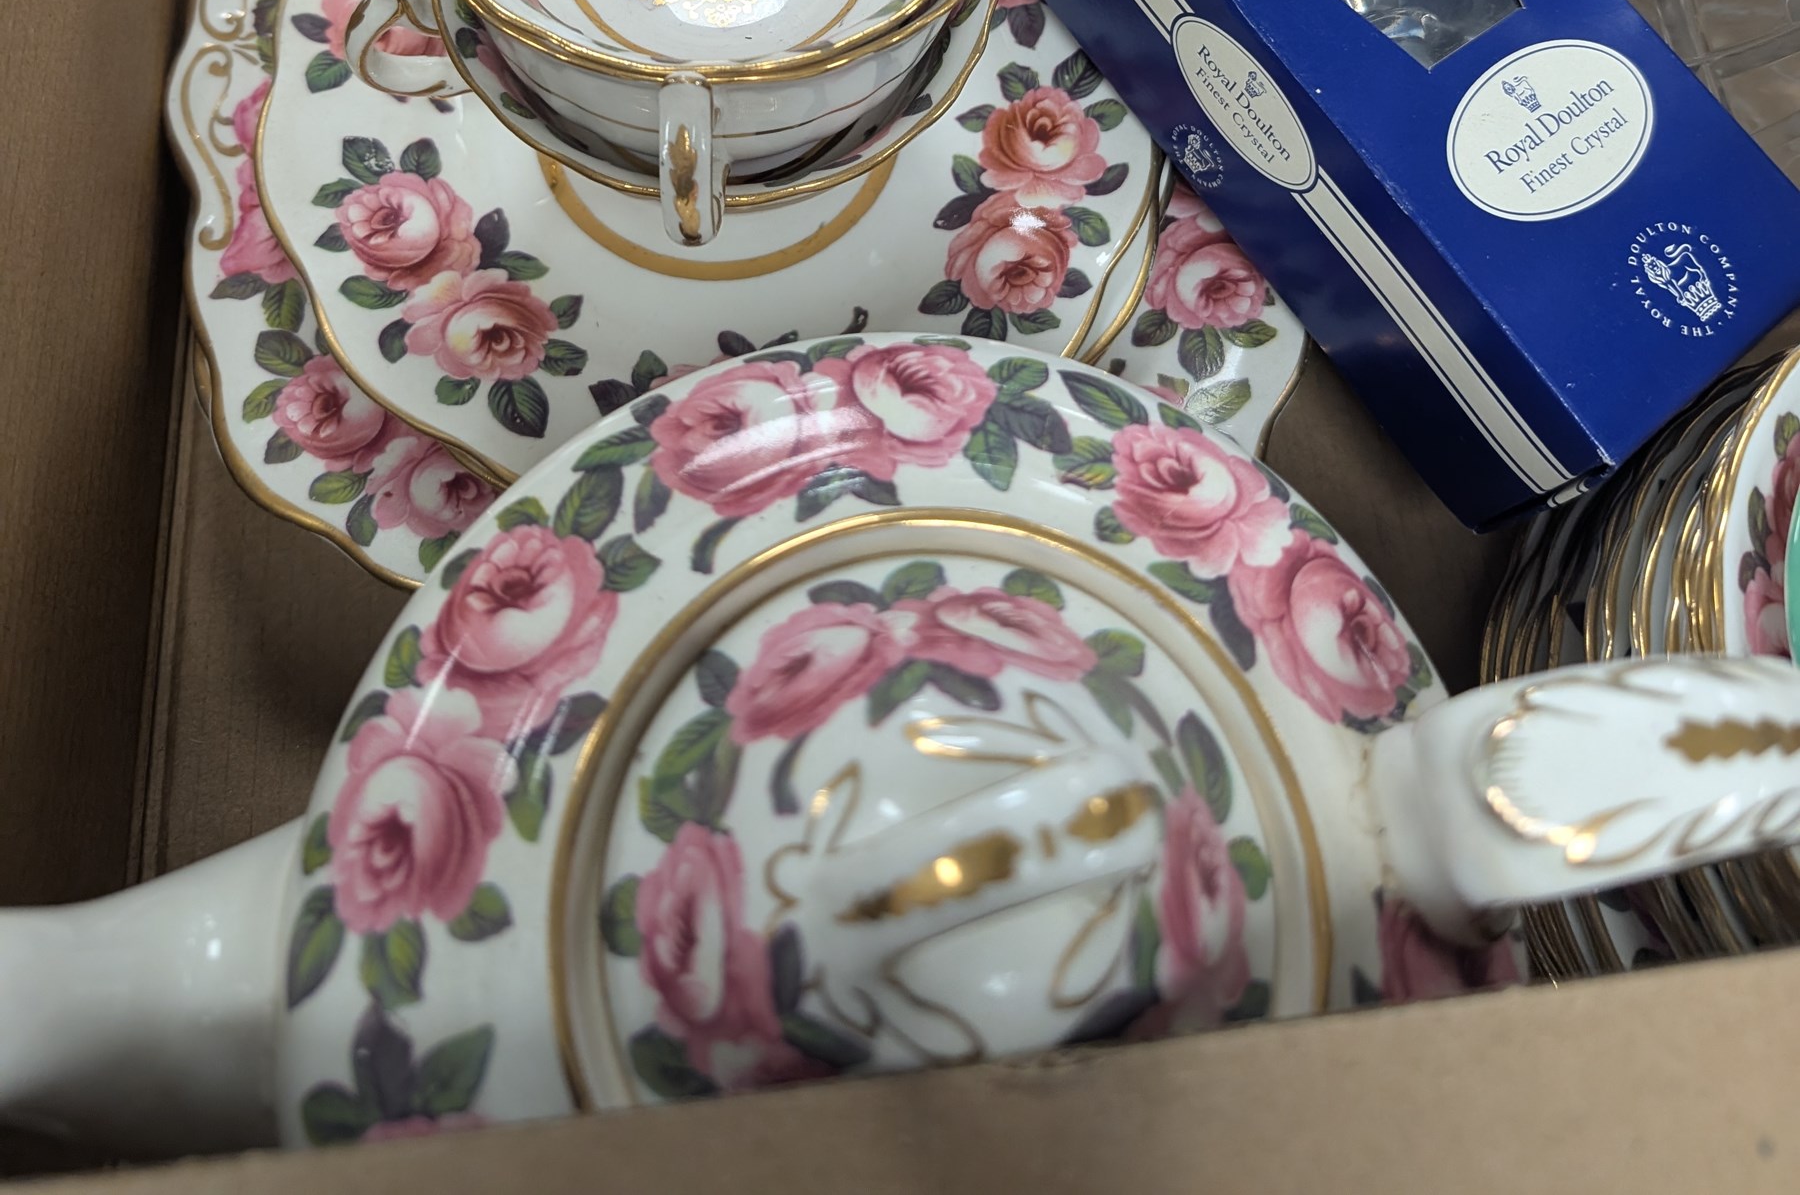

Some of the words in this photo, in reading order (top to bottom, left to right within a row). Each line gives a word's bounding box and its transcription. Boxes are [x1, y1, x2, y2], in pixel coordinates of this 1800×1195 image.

[1195, 67, 1230, 111] Finest
[1232, 112, 1276, 163] Crystal
[1197, 44, 1237, 93] Royal
[1235, 91, 1291, 161] Doulton
[1484, 123, 1544, 174] Royal
[1535, 80, 1615, 137] Doulton
[1519, 152, 1573, 194] Finest
[1570, 108, 1628, 155] Crystal
[1627, 222, 1692, 266] DOULTON
[1699, 234, 1738, 319] COMPANY
[1630, 275, 1671, 328] ROYAL
[1680, 325, 1714, 337] THE
